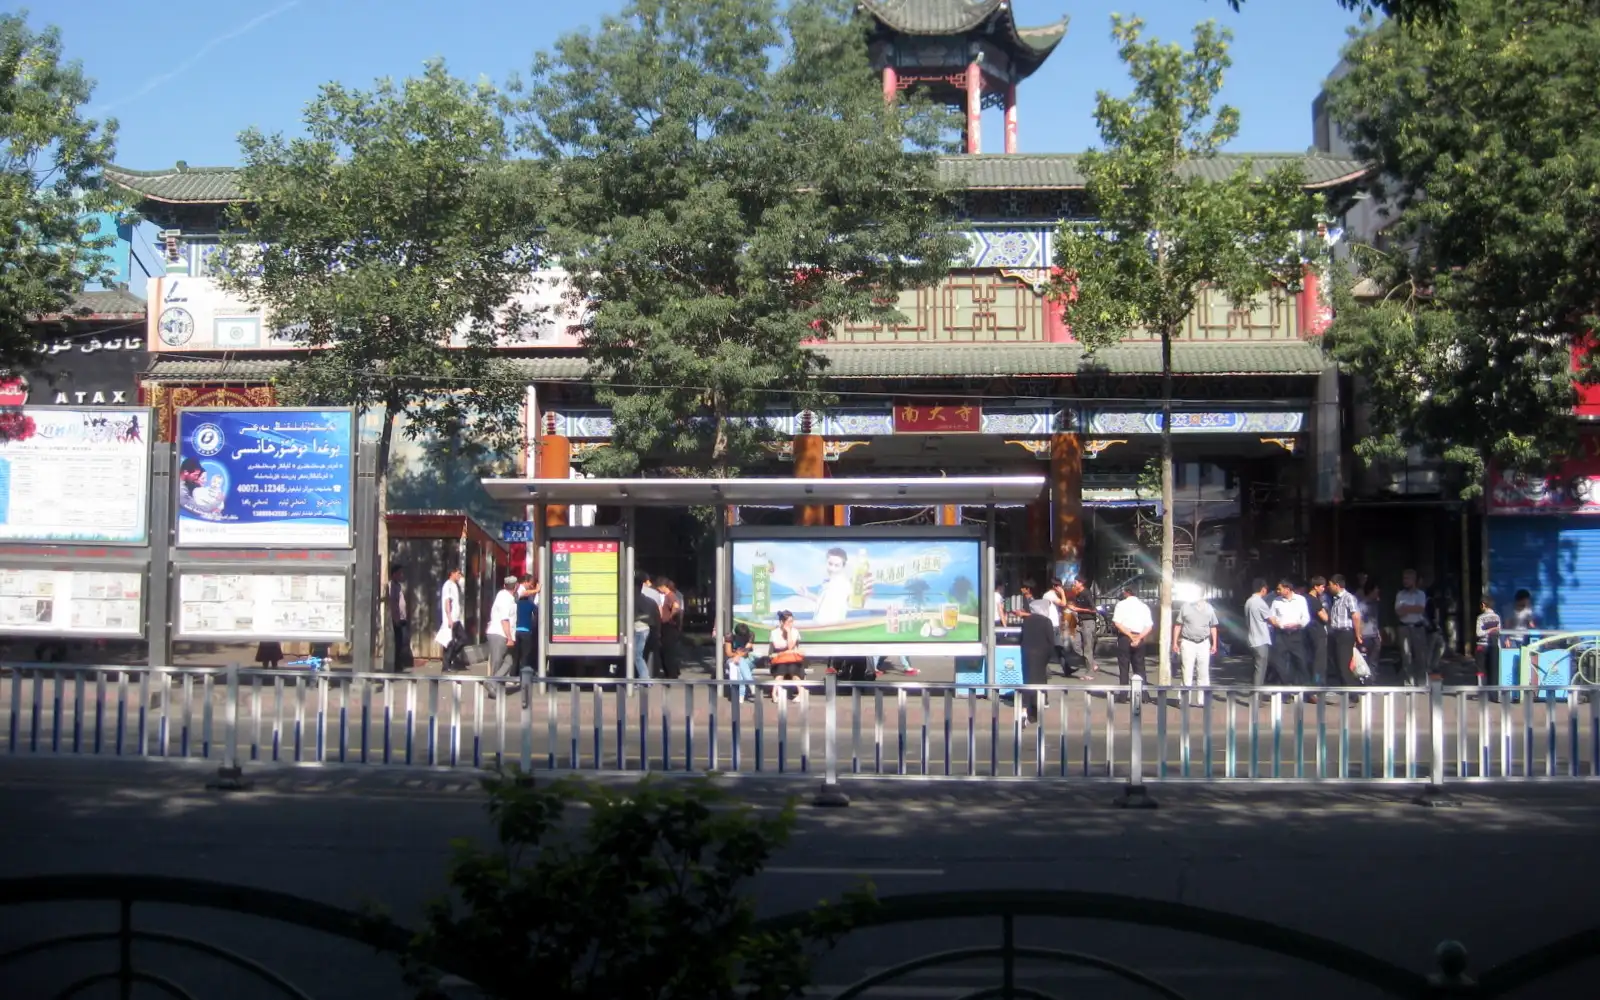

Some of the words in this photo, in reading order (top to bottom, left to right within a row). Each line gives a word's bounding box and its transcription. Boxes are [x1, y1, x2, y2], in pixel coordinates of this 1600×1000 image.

[55, 391, 126, 403] ATAX
[901, 403, 973, 423] 南大寺
[511, 530, 526, 538] 791
[555, 553, 567, 562] 61
[553, 618, 569, 626] 911
